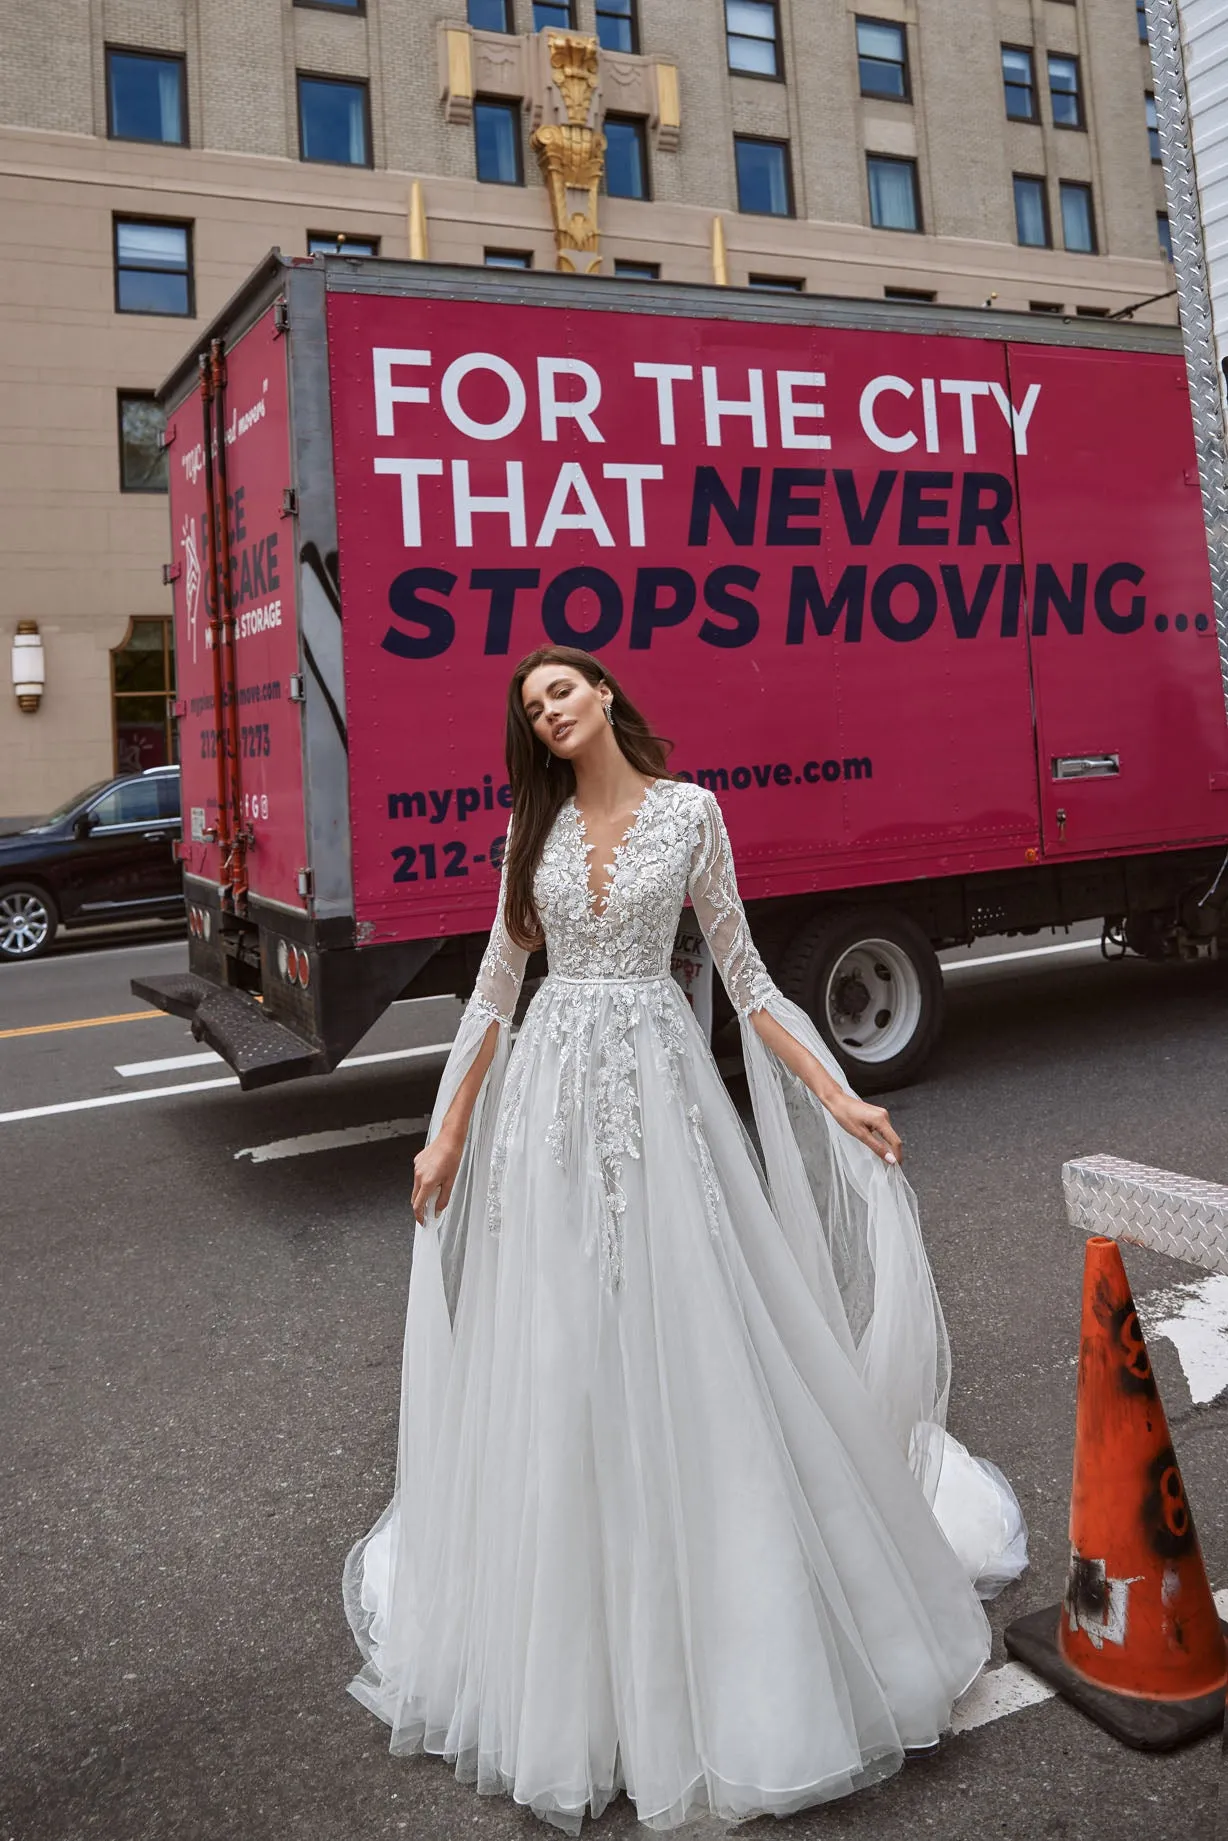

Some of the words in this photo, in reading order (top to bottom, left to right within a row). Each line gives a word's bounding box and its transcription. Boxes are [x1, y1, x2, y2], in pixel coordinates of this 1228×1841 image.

[373, 347, 606, 443] FOR
[634, 361, 832, 449] THE
[859, 374, 1042, 456] CITY
[373, 457, 664, 548] THAT
[688, 465, 1014, 547] NEVER
[241, 600, 282, 639] STORAGE
[380, 565, 761, 660] STOPS
[786, 561, 1209, 645] MOVING...
